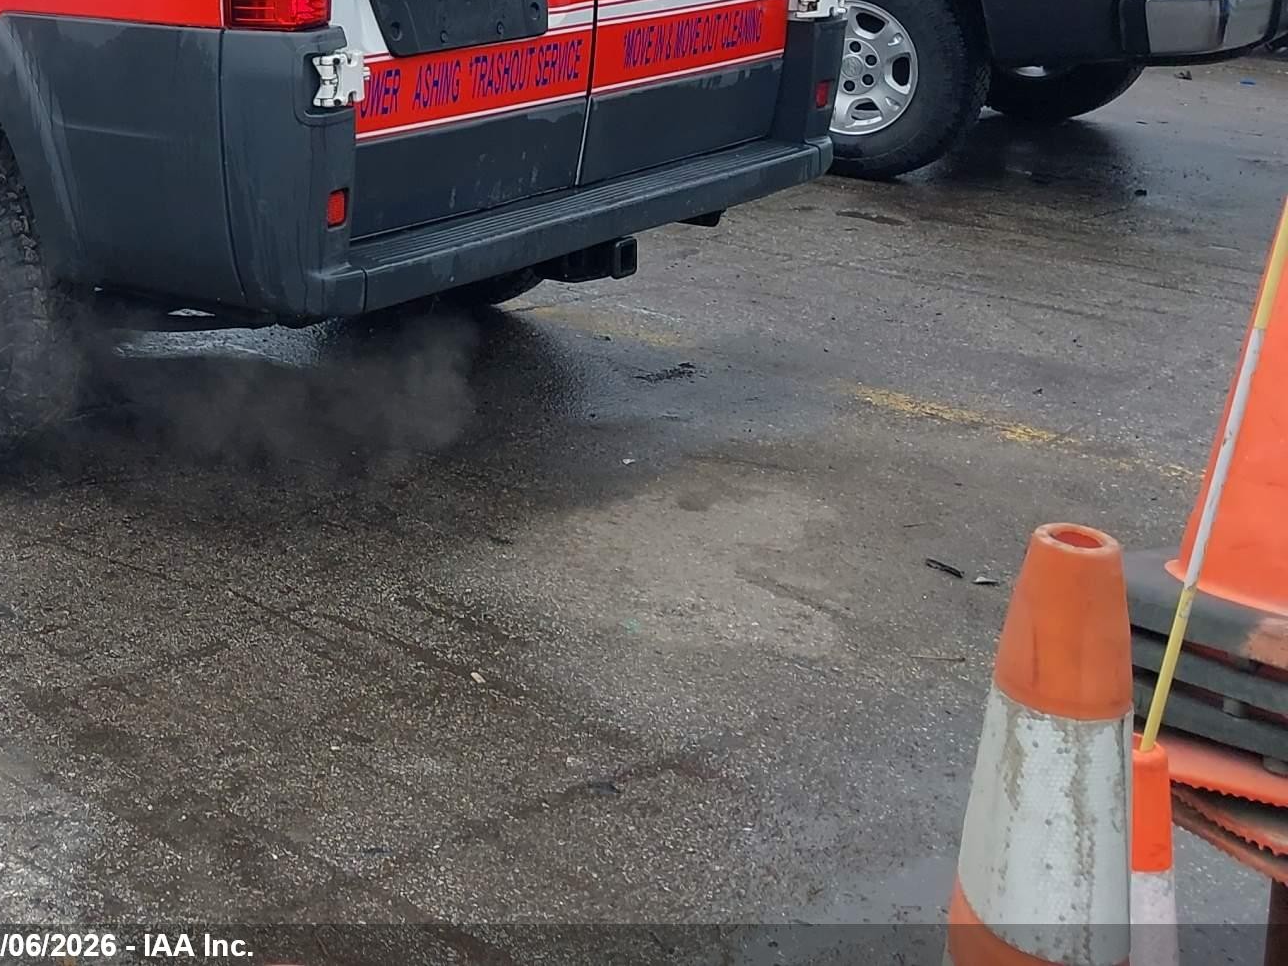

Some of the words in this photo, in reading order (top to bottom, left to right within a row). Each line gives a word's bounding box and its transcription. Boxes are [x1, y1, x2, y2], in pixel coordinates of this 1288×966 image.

[654, 23, 666, 62] IN
[673, 16, 702, 59] MOVE
[701, 13, 722, 54] OUT
[721, 7, 765, 50] CLEANING
[359, 68, 402, 119] OWER
[535, 39, 584, 87] SERVICE
